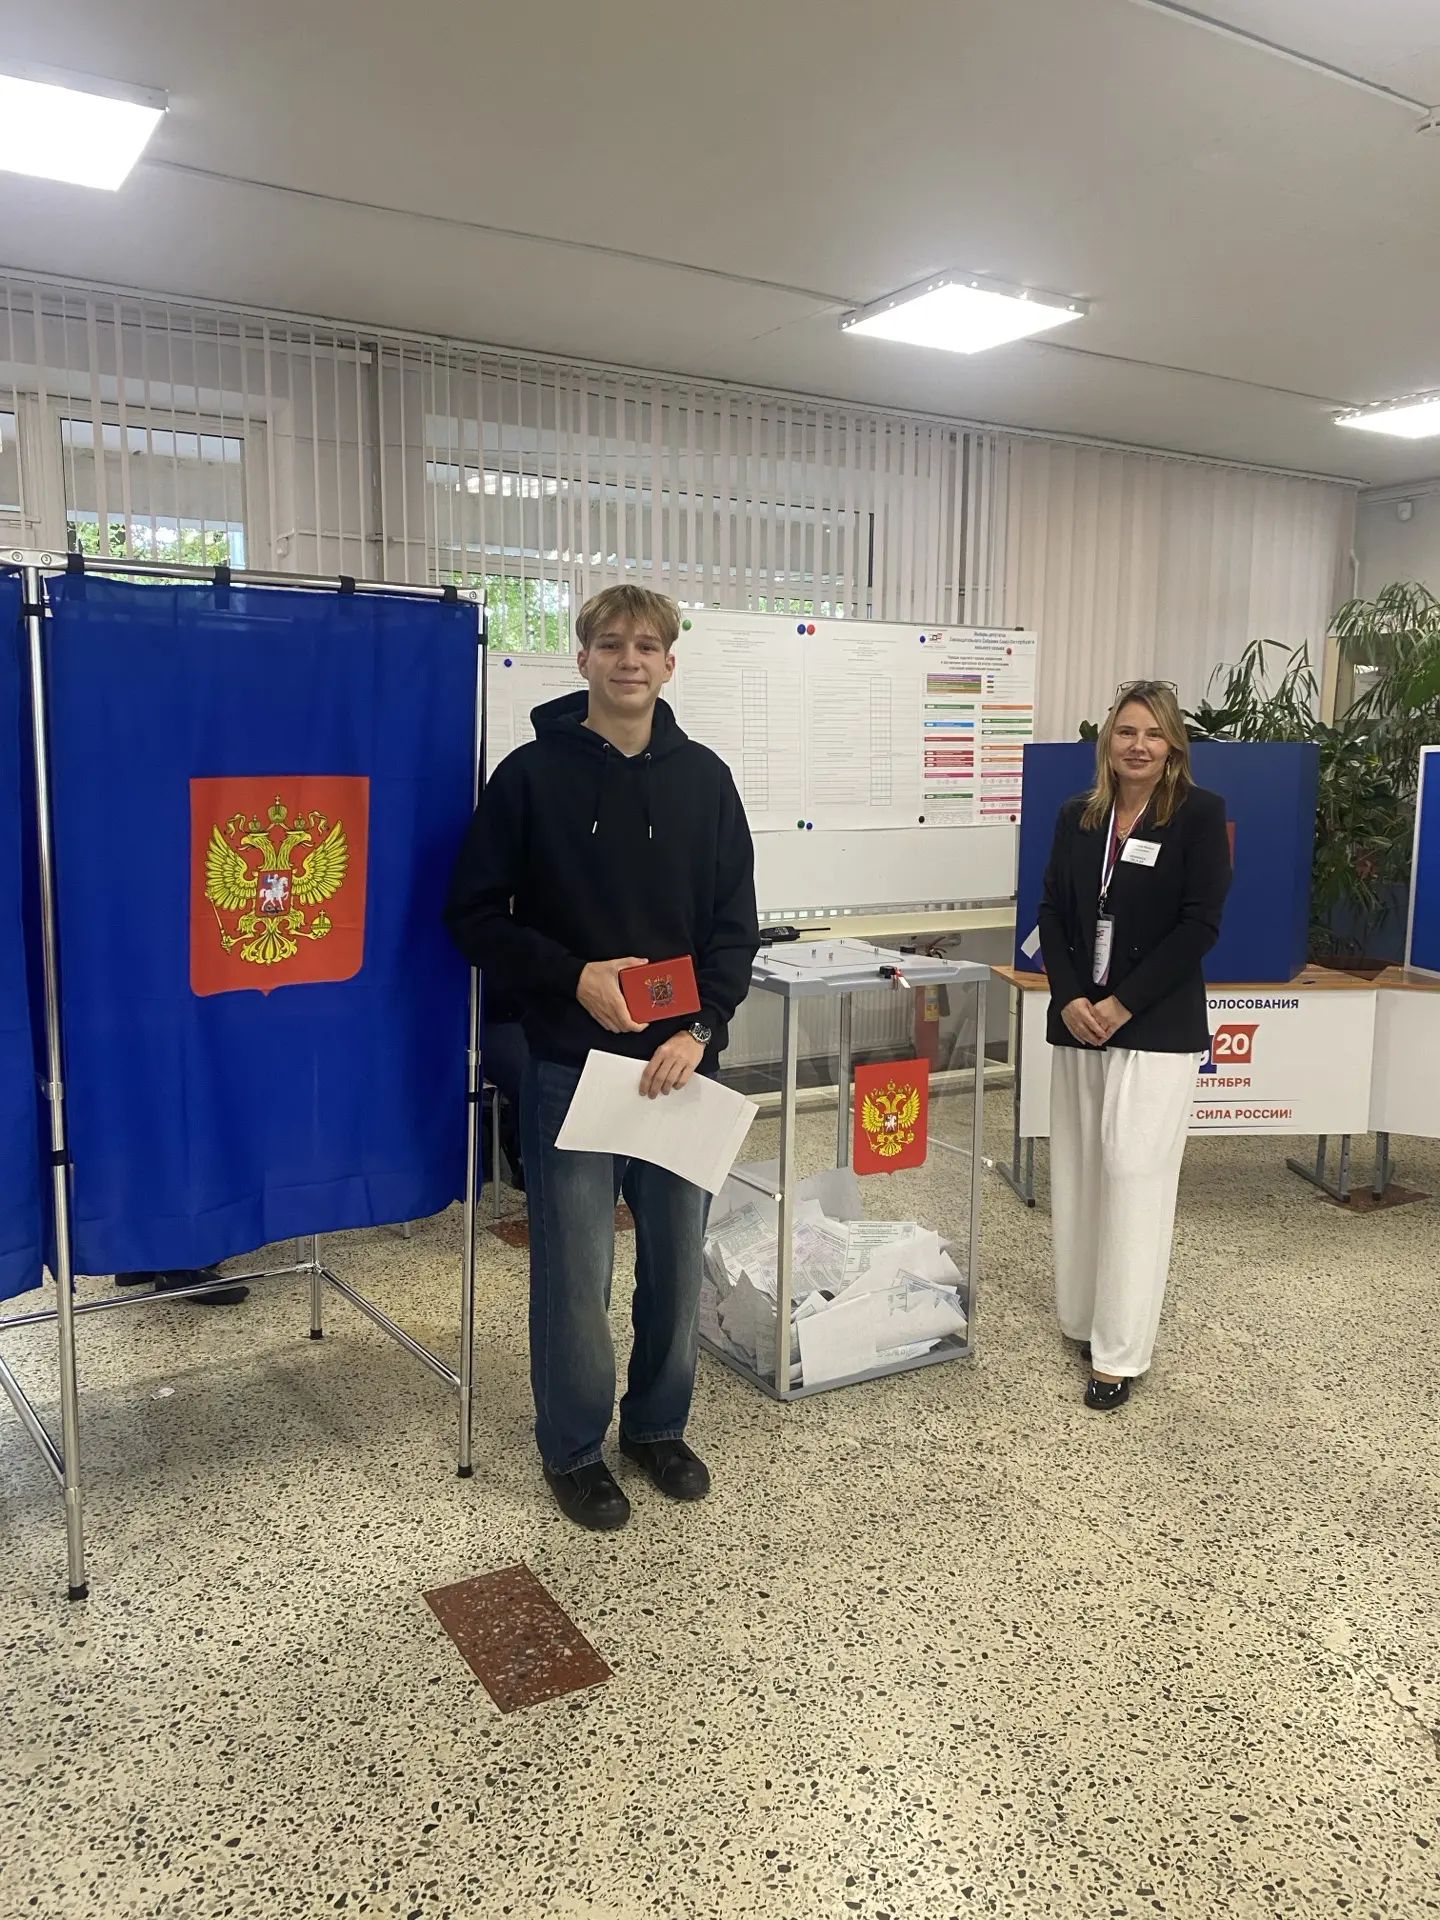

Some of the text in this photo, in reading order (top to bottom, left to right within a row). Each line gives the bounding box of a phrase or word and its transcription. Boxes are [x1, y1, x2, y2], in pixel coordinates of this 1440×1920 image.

[1206, 999, 1299, 1009] ОЛОСОВАНИЯ
[1215, 1033, 1250, 1055] 20
[1196, 1109, 1232, 1119] СИЛА
[1235, 1109, 1292, 1119] РОССИИ!
